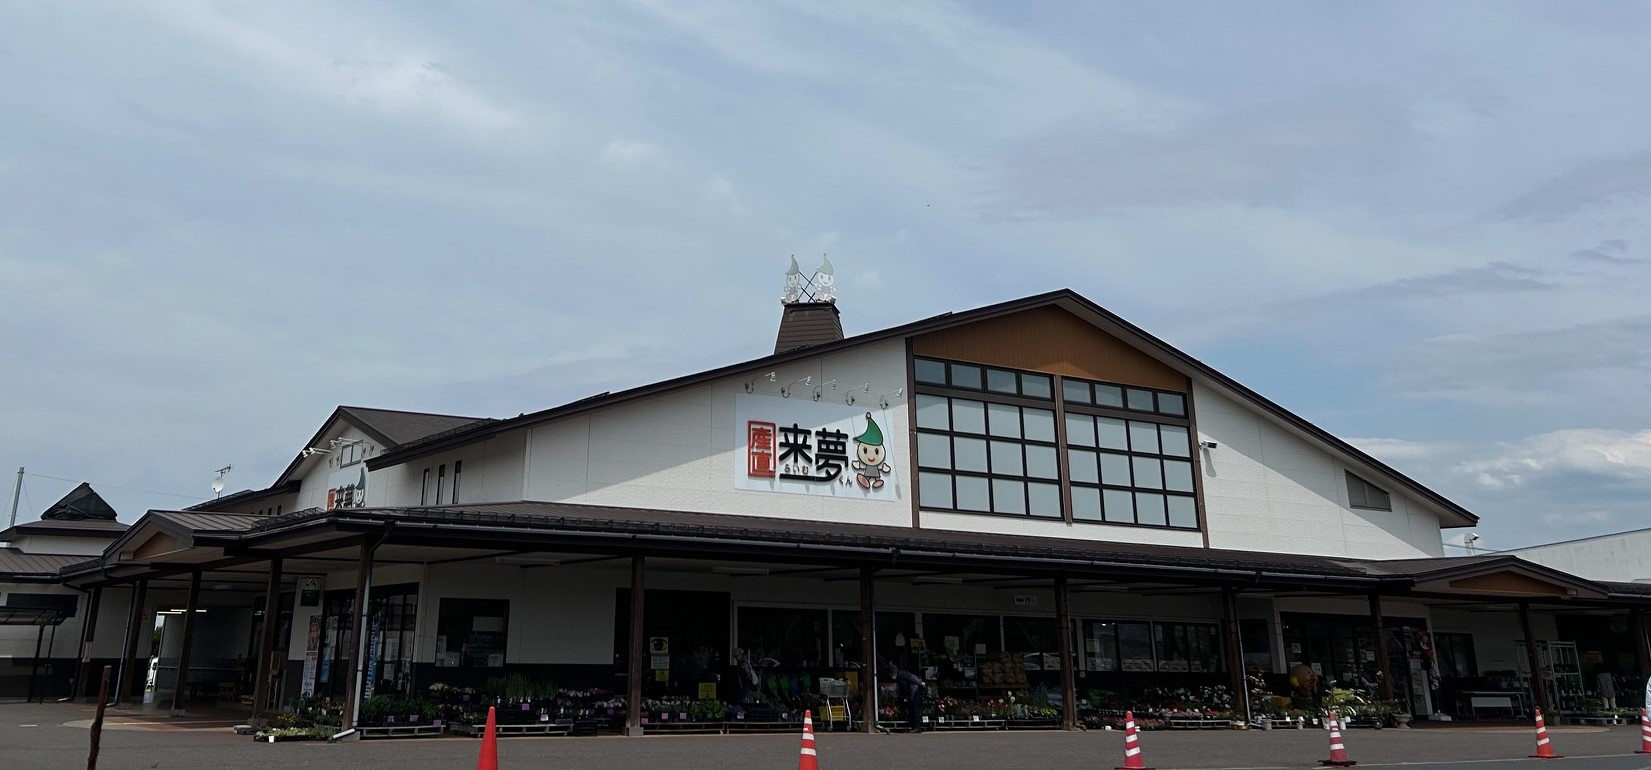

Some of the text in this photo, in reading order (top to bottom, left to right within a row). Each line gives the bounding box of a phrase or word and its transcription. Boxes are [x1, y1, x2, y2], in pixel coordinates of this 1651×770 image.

[752, 426, 774, 476] 産直
[779, 423, 849, 482] 来夢
[784, 464, 810, 475] らいむ
[838, 475, 853, 488] くん
